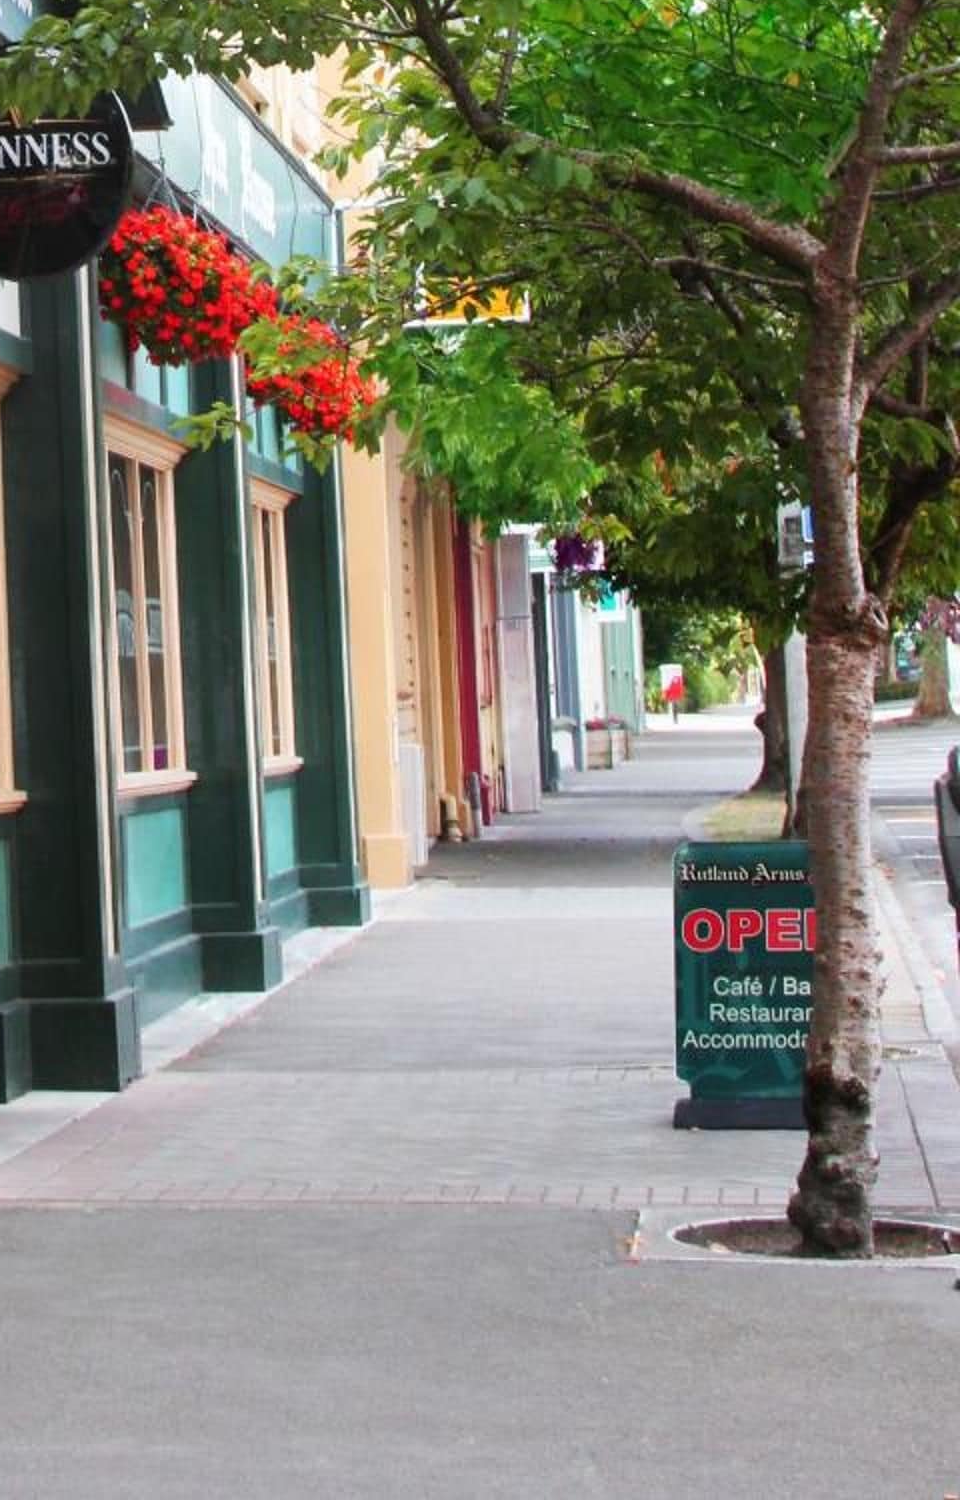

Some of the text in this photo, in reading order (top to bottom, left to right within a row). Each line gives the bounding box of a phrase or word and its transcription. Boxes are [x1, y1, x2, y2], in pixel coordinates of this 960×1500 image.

[680, 863, 749, 883] Rutland
[751, 863, 805, 886] Arms
[713, 975, 763, 997] Café
[783, 976, 812, 996] Ba
